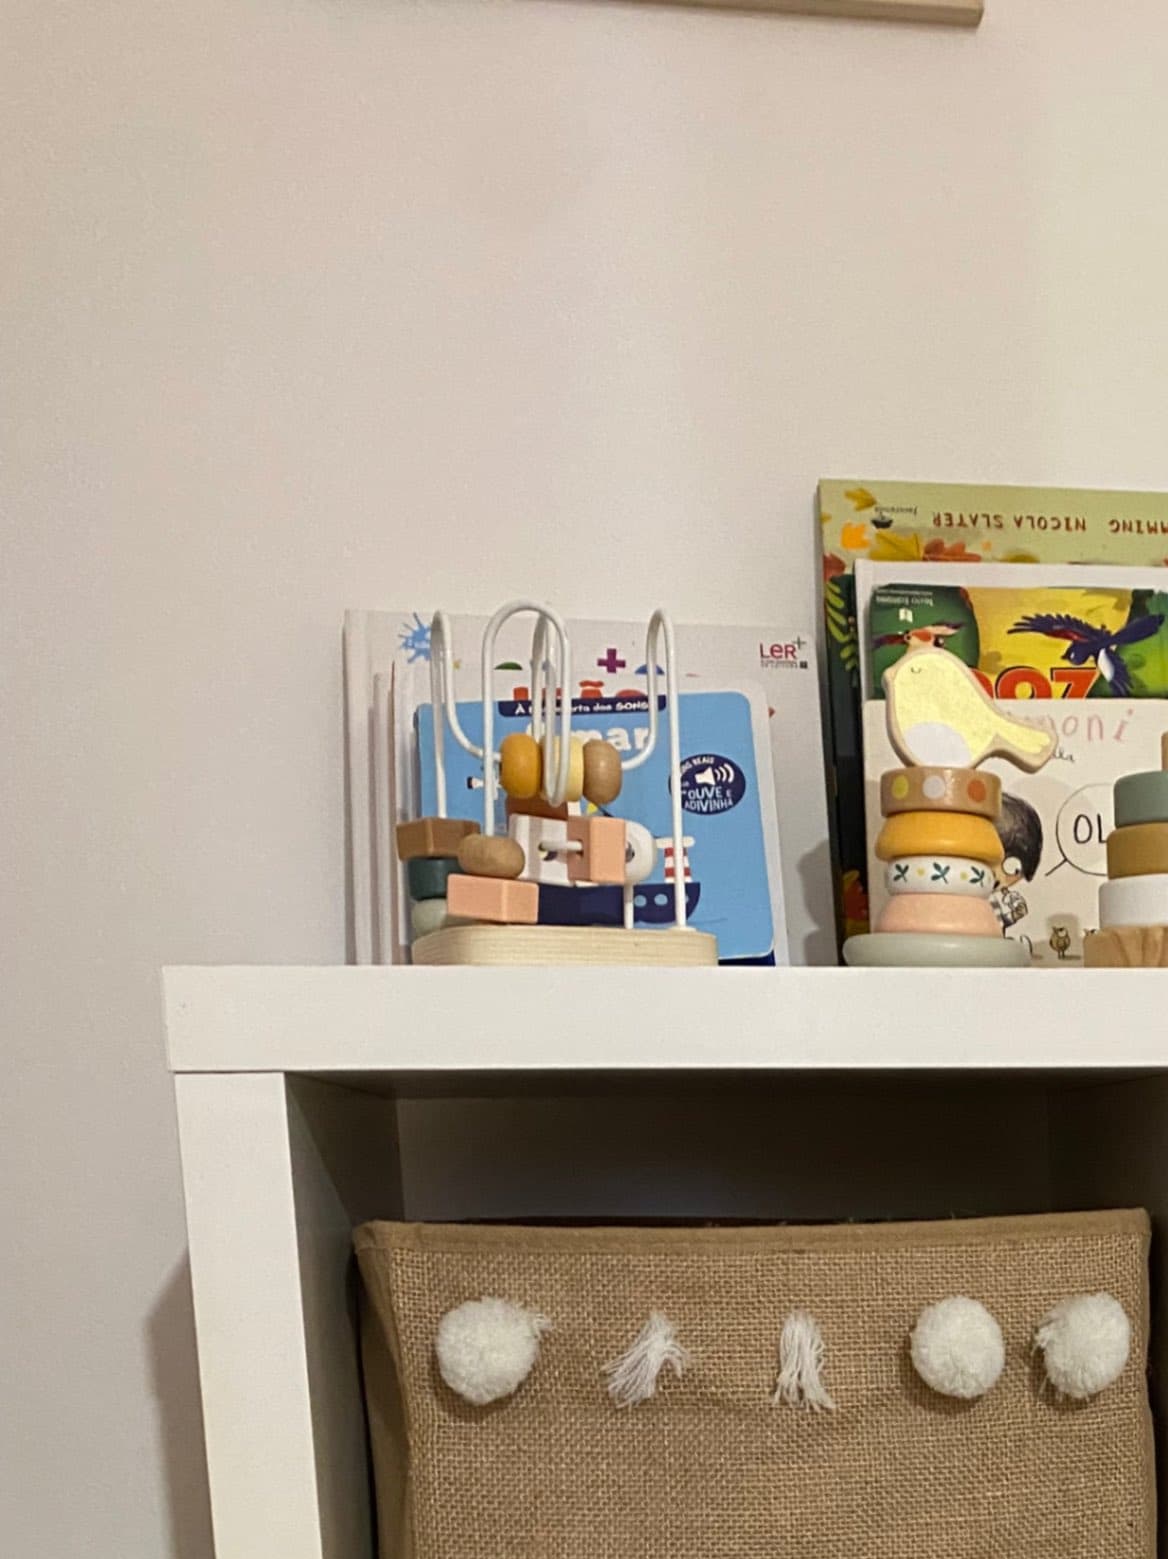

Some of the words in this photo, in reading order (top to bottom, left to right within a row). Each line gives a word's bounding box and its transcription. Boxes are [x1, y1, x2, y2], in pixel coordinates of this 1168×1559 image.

[932, 511, 1004, 528] SLATER
[1013, 514, 1087, 532] NICOLA
[687, 786, 723, 800] OUVE
[684, 798, 734, 813] ADIVINHA
[1073, 812, 1108, 845] OL
